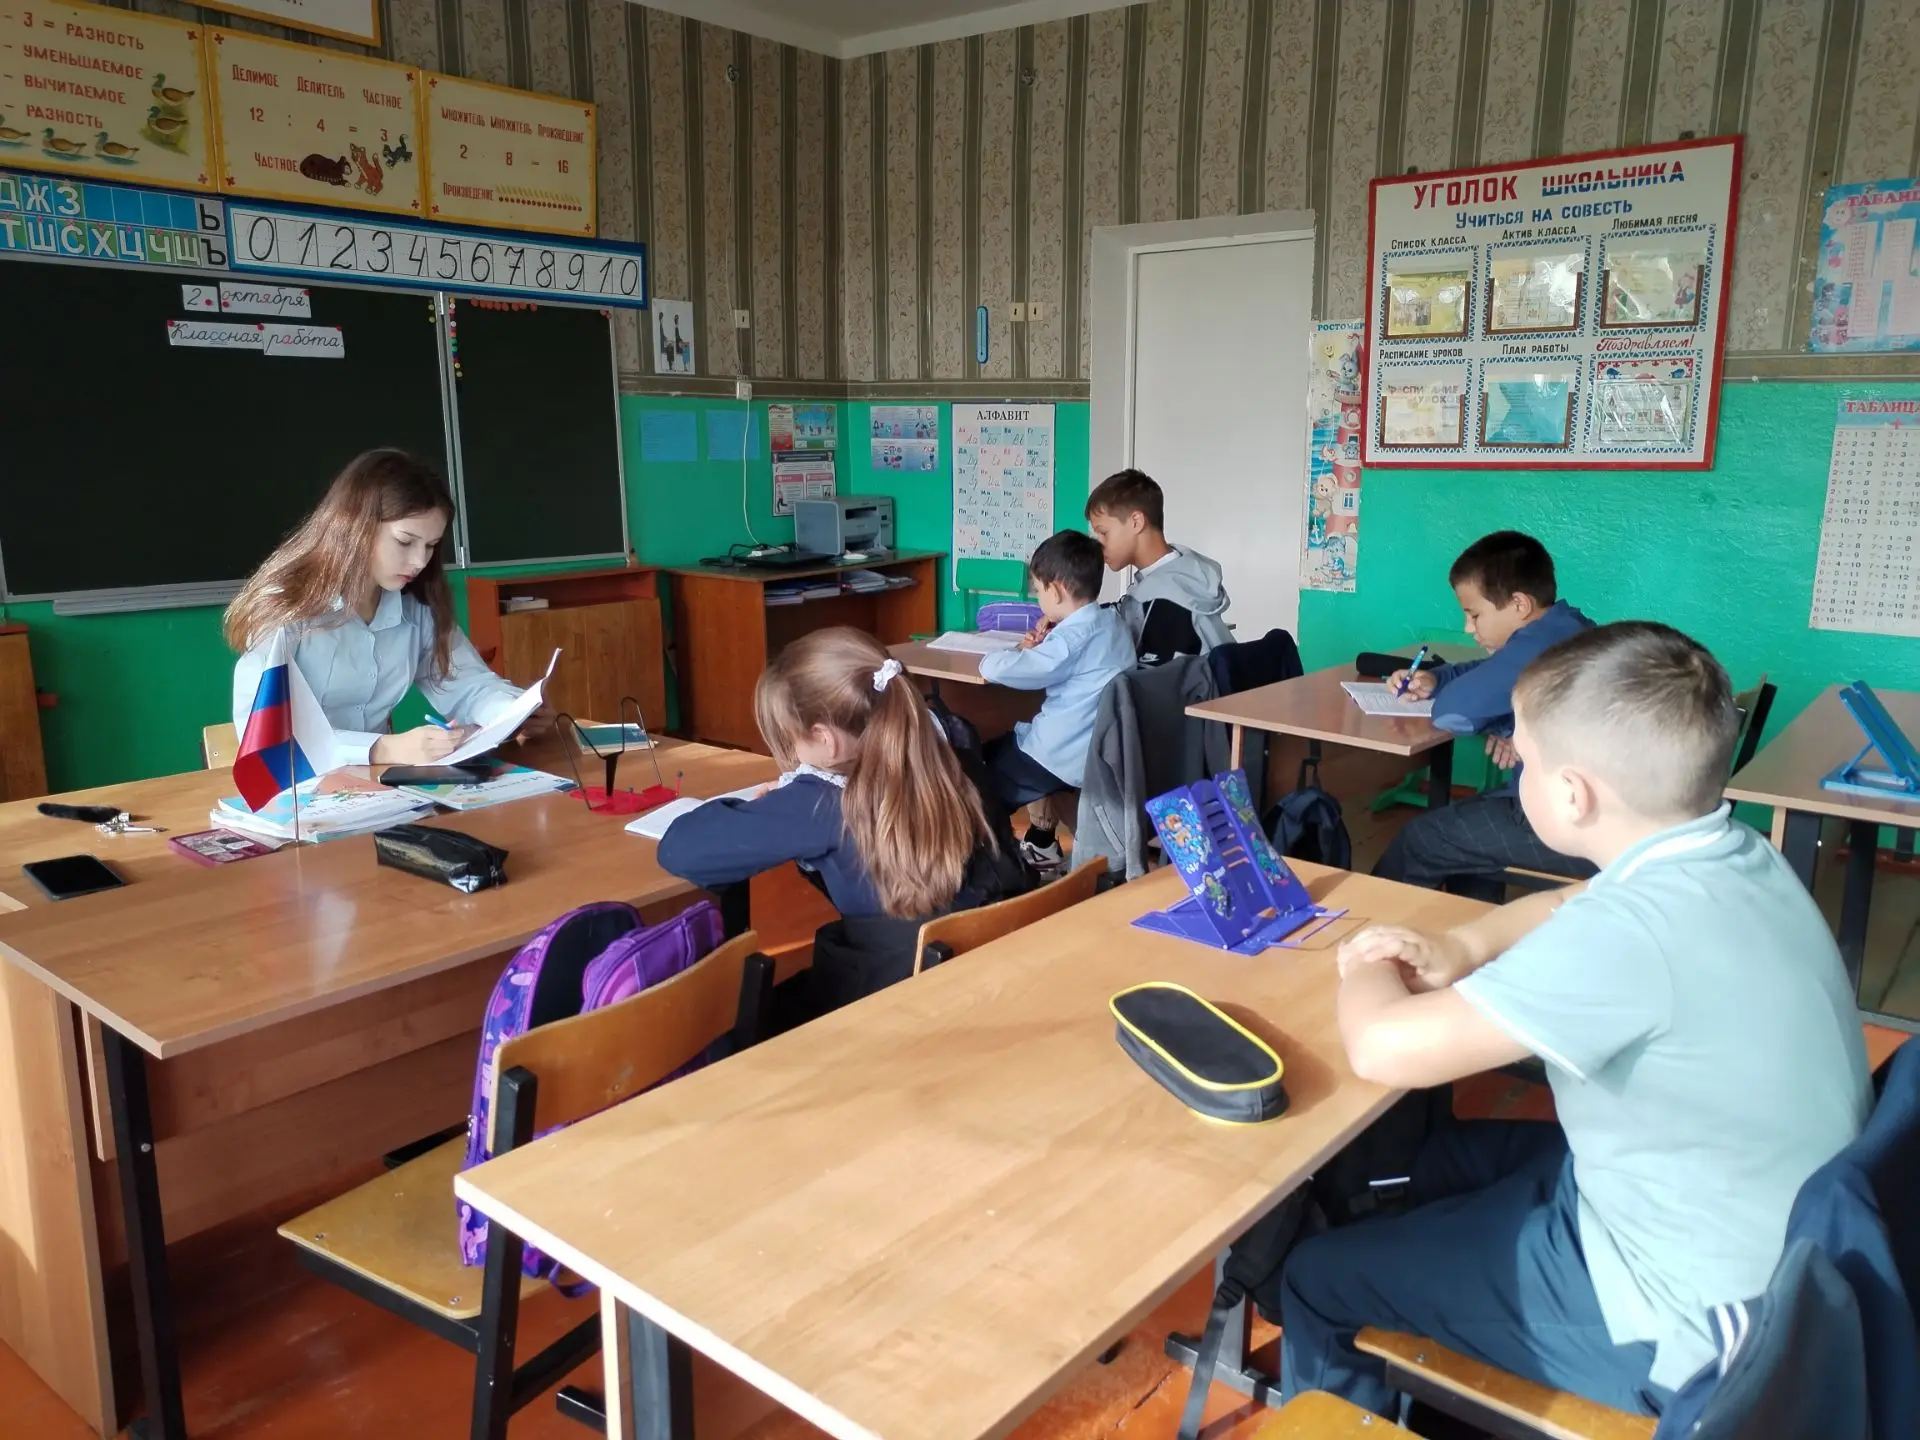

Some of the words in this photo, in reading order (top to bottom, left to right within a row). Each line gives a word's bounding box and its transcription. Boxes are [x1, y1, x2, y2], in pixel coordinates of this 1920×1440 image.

[24, 12, 33, 28] 3
[66, 23, 144, 51] РАЗНОСТЬ
[23, 44, 144, 80] УМЕНЬШАЕМОЕ
[24, 74, 127, 105] ВЫЧИТАЕМОЕ
[26, 104, 103, 129] РАЗНОСТЬ
[250, 107, 264, 122] 12
[316, 119, 325, 132] 4
[380, 128, 388, 142] 3
[459, 144, 468, 159] 2
[506, 152, 513, 166] 8
[558, 160, 569, 174] 16
[22, 182, 51, 213] Ж
[56, 186, 81, 215] З
[1413, 176, 1518, 209] УГОЛОК
[1542, 160, 1685, 197] ШКОЛЬНИКА
[27, 222, 57, 251] Ш
[61, 224, 85, 254] С
[91, 228, 115, 257] Х
[119, 230, 145, 261] Ц
[150, 234, 172, 263] Ч
[174, 235, 201, 266] Щ
[249, 216, 275, 261] 0
[298, 222, 316, 265] 1
[329, 226, 355, 269] 2
[366, 231, 392, 273] 3
[408, 235, 426, 276] 4
[436, 239, 460, 279] 5
[471, 242, 493, 282] 6
[504, 246, 525, 285] 7
[535, 250, 554, 288] 8
[565, 254, 584, 290] 9
[1596, 334, 1695, 352] Поздравляем!
[976, 410, 1030, 421] АЛФАВИТ
